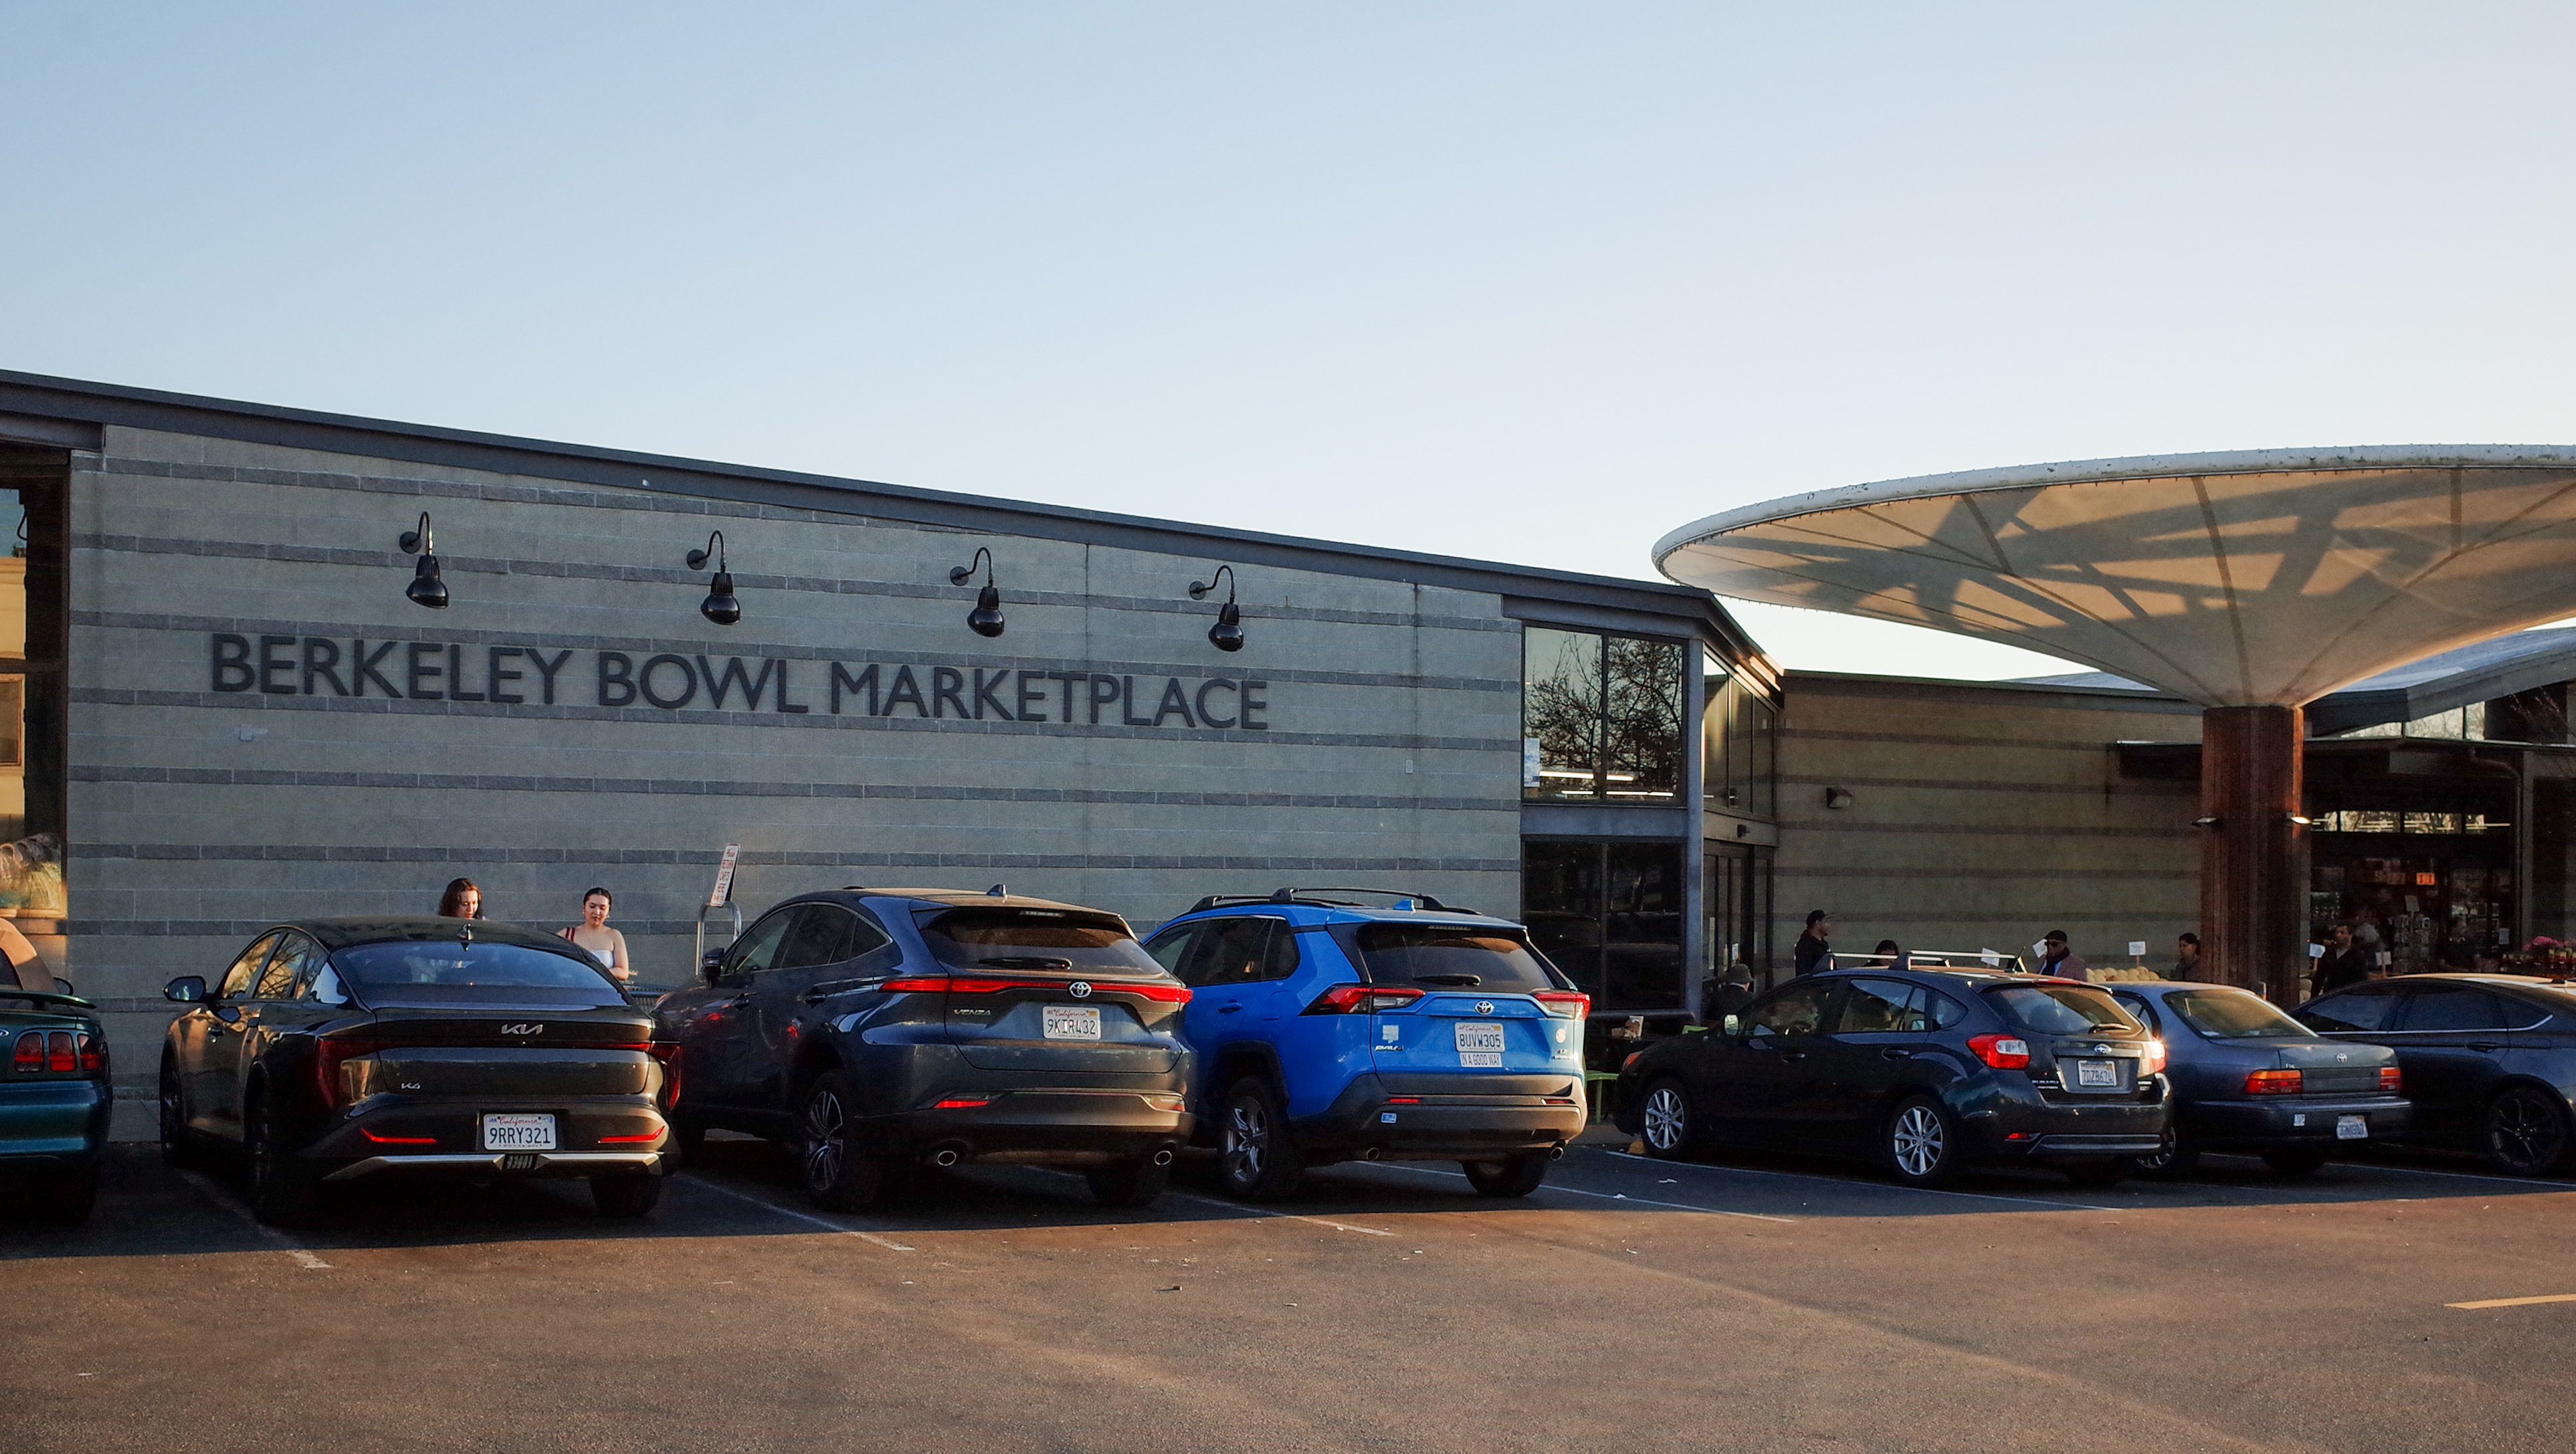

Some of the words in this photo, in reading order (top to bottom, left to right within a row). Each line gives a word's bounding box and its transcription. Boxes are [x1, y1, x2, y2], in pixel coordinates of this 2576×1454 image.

[213, 633, 573, 704] BERKELEY
[599, 651, 808, 714] BOWL
[831, 661, 1268, 729] MARKETPLACE
[1055, 1009, 1088, 1018] California
[500, 1023, 543, 1035] KIA
[1048, 1019, 1096, 1035] 9KIR432
[1460, 1033, 1501, 1047] 8UVW305
[1468, 1054, 1473, 1065] A
[1473, 1054, 1488, 1065] GOOD
[1489, 1054, 1500, 1065] WAY
[499, 1116, 542, 1127] California
[490, 1127, 551, 1144] 9RRY321
